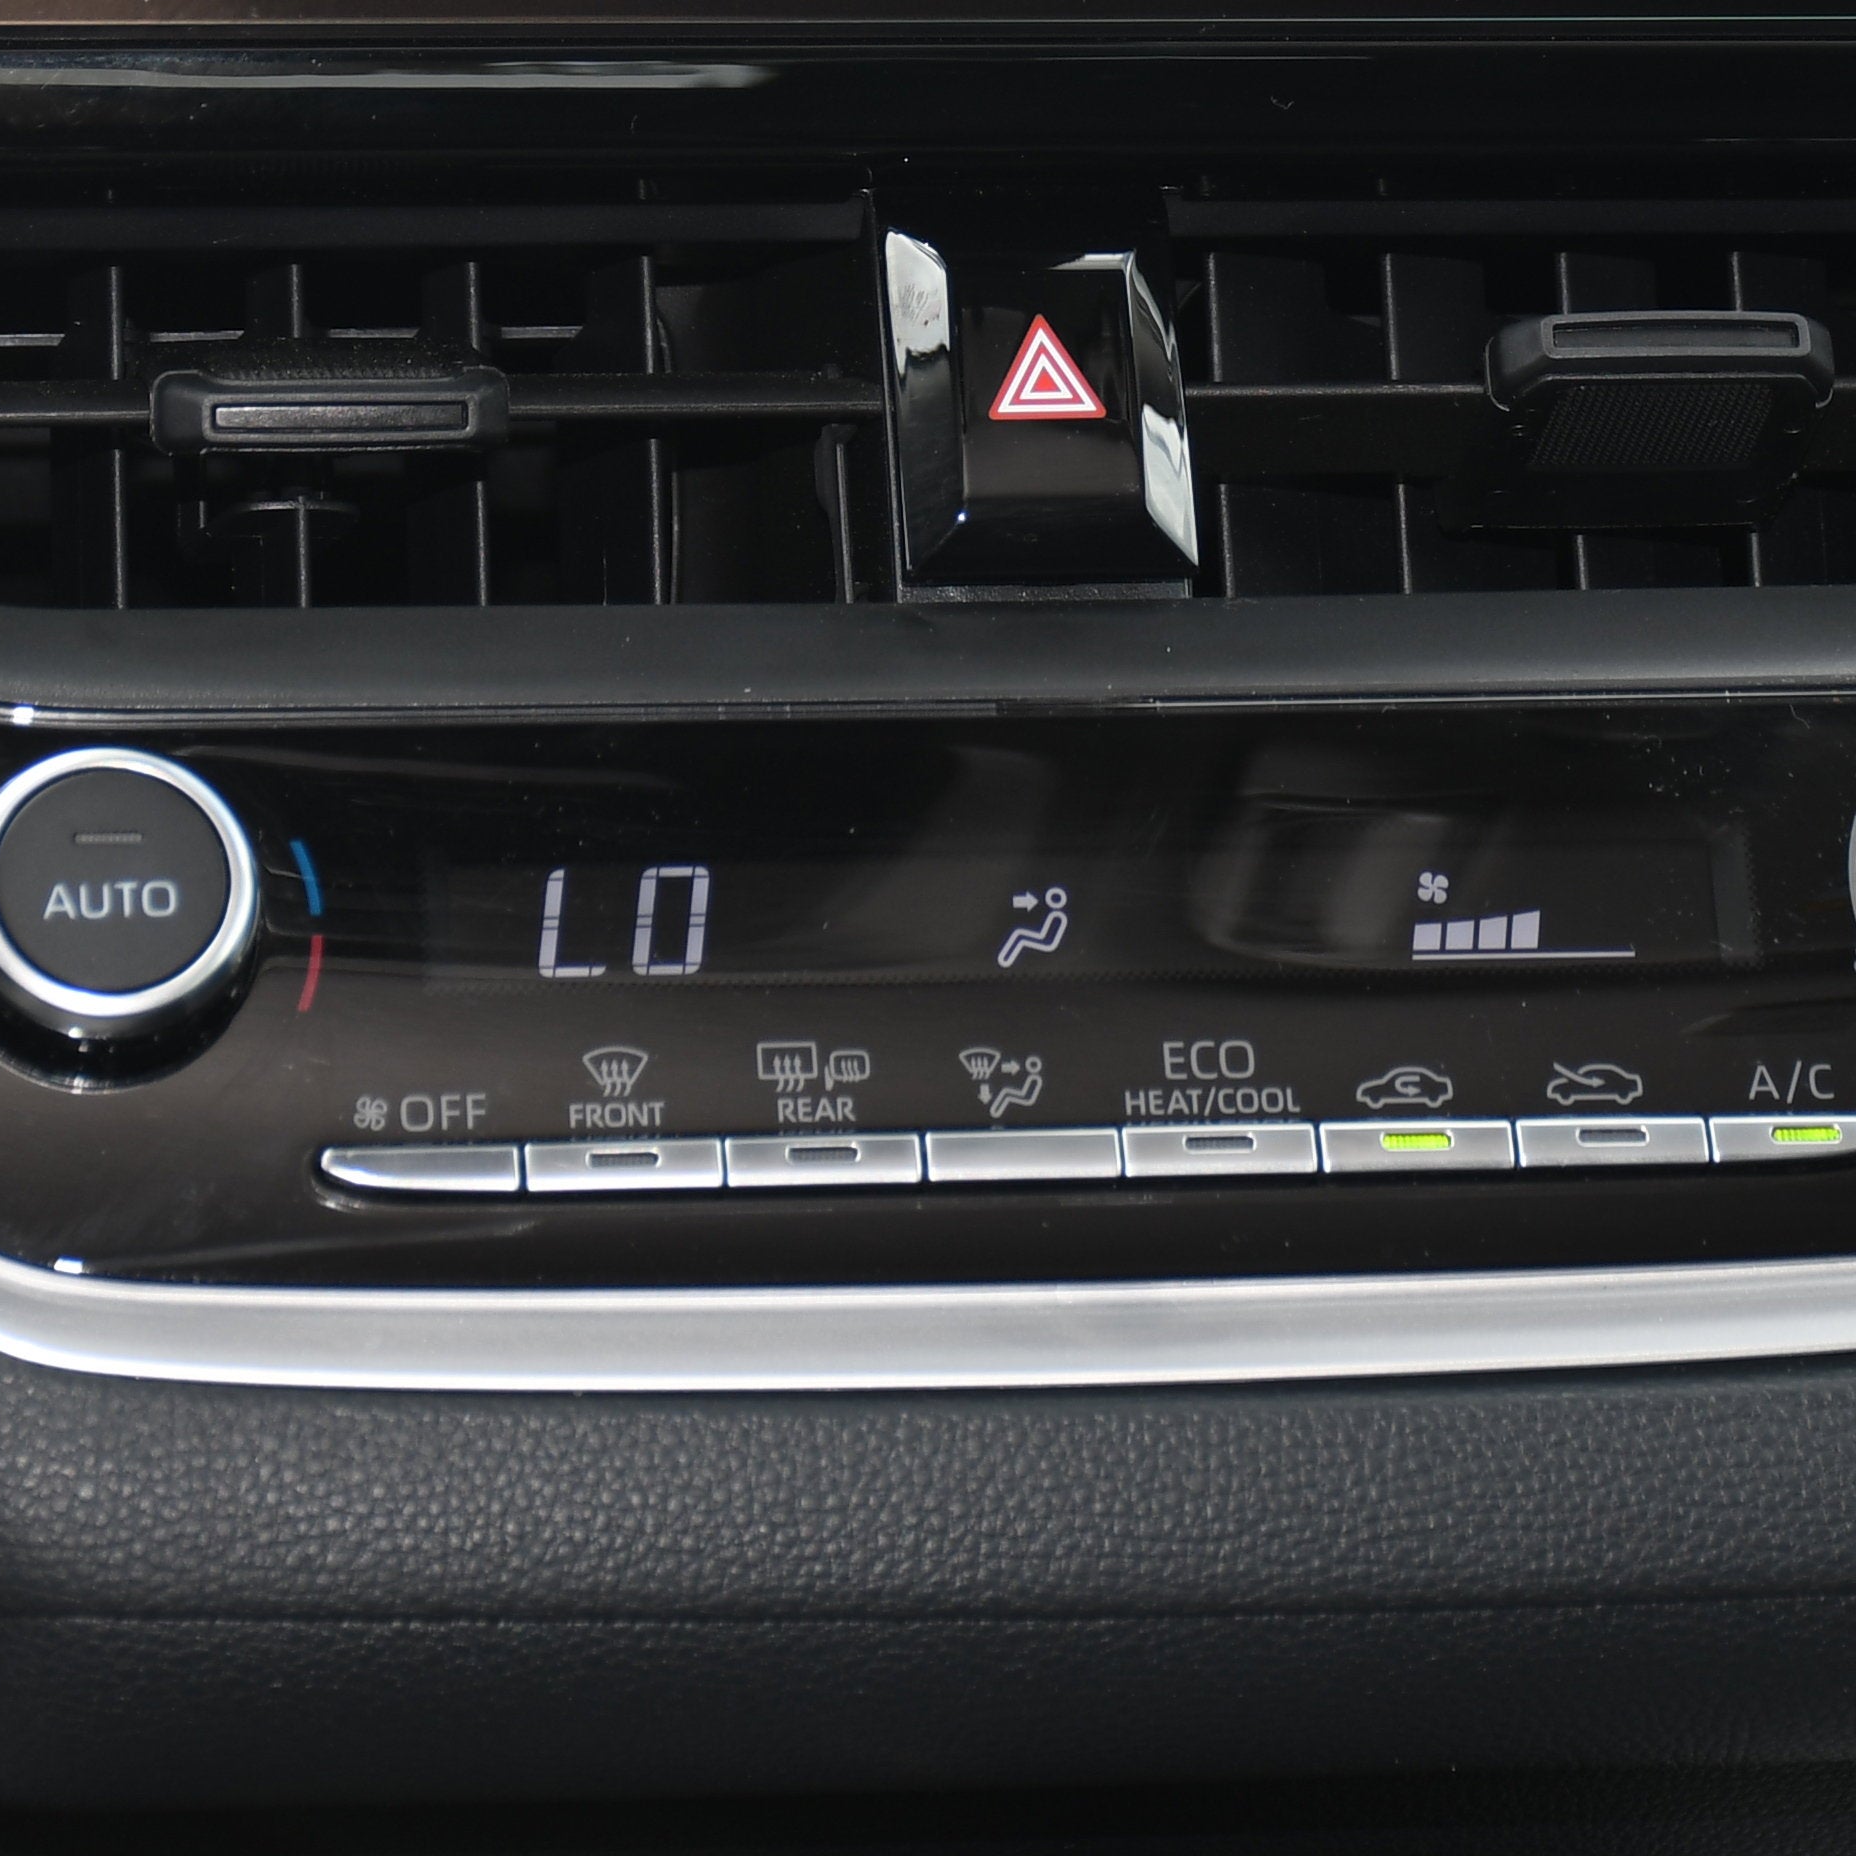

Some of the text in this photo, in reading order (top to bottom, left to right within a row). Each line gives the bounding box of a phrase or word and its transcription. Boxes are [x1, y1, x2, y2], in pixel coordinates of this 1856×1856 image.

[42, 879, 179, 921] AUTO
[537, 865, 711, 980] LO
[1161, 1039, 1256, 1081] ECO
[1123, 1087, 1302, 1117] HEAT/COOL
[1747, 1059, 1836, 1104] A/C
[399, 1092, 488, 1133] OFF
[568, 1100, 666, 1129] FRONT
[776, 1097, 857, 1124] REAR
